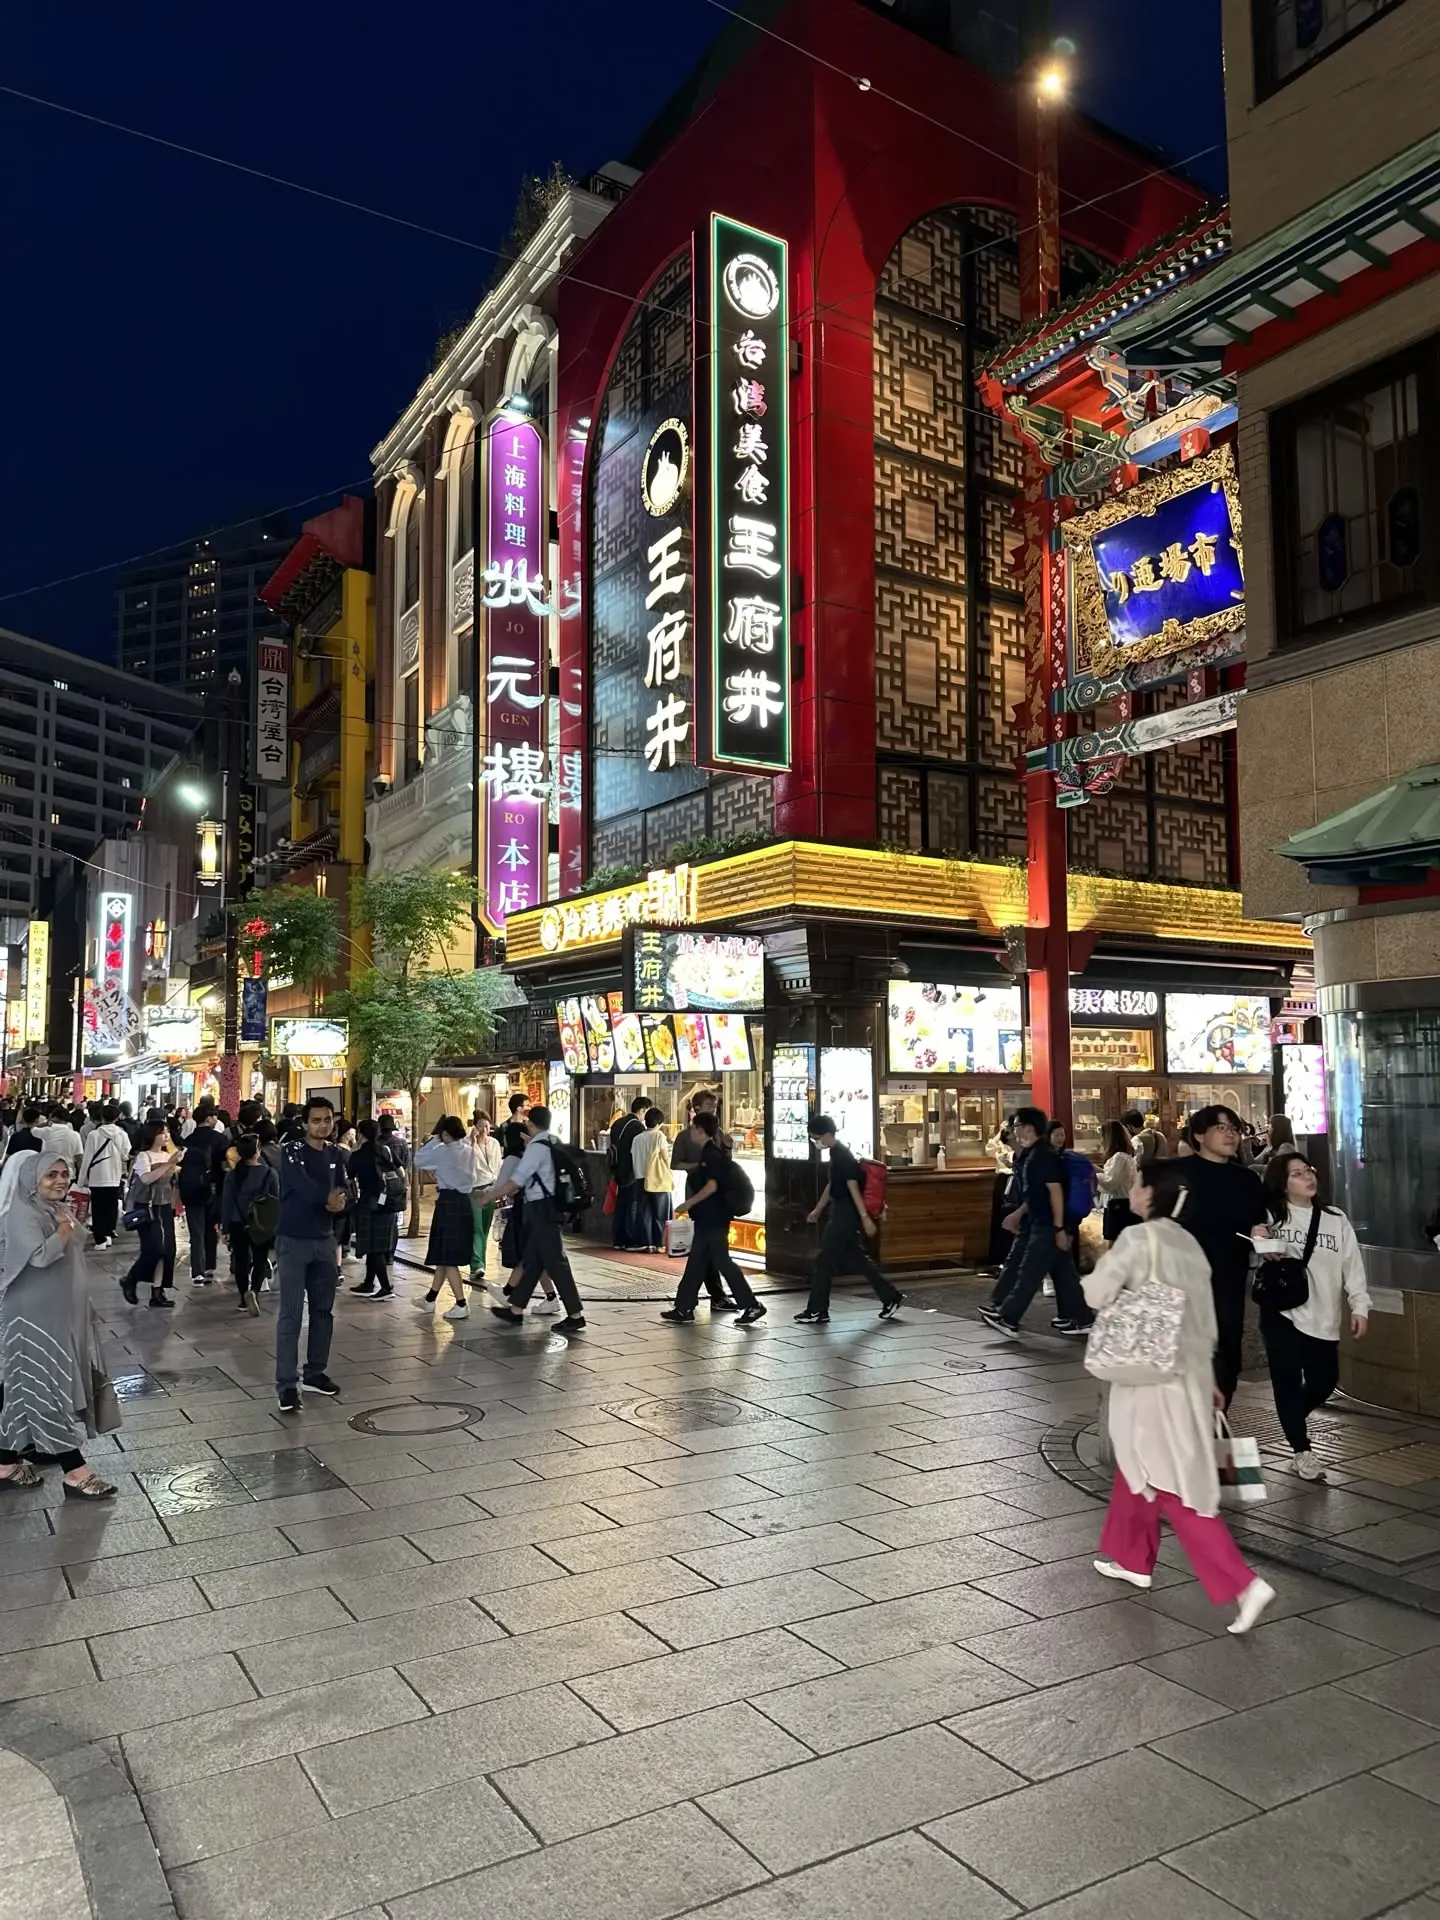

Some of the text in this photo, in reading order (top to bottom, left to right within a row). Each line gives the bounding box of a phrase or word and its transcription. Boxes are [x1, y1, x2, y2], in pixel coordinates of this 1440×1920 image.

[504, 436, 527, 548] 上海料理
[1108, 532, 1219, 604] 市場通り
[643, 526, 690, 772] 王府井
[723, 515, 784, 729] 王府井
[259, 677, 287, 764] 台湾屋台
[500, 621, 531, 825] JO GEN RO
[497, 837, 531, 914] 本店
[640, 931, 665, 1008] 王府井
